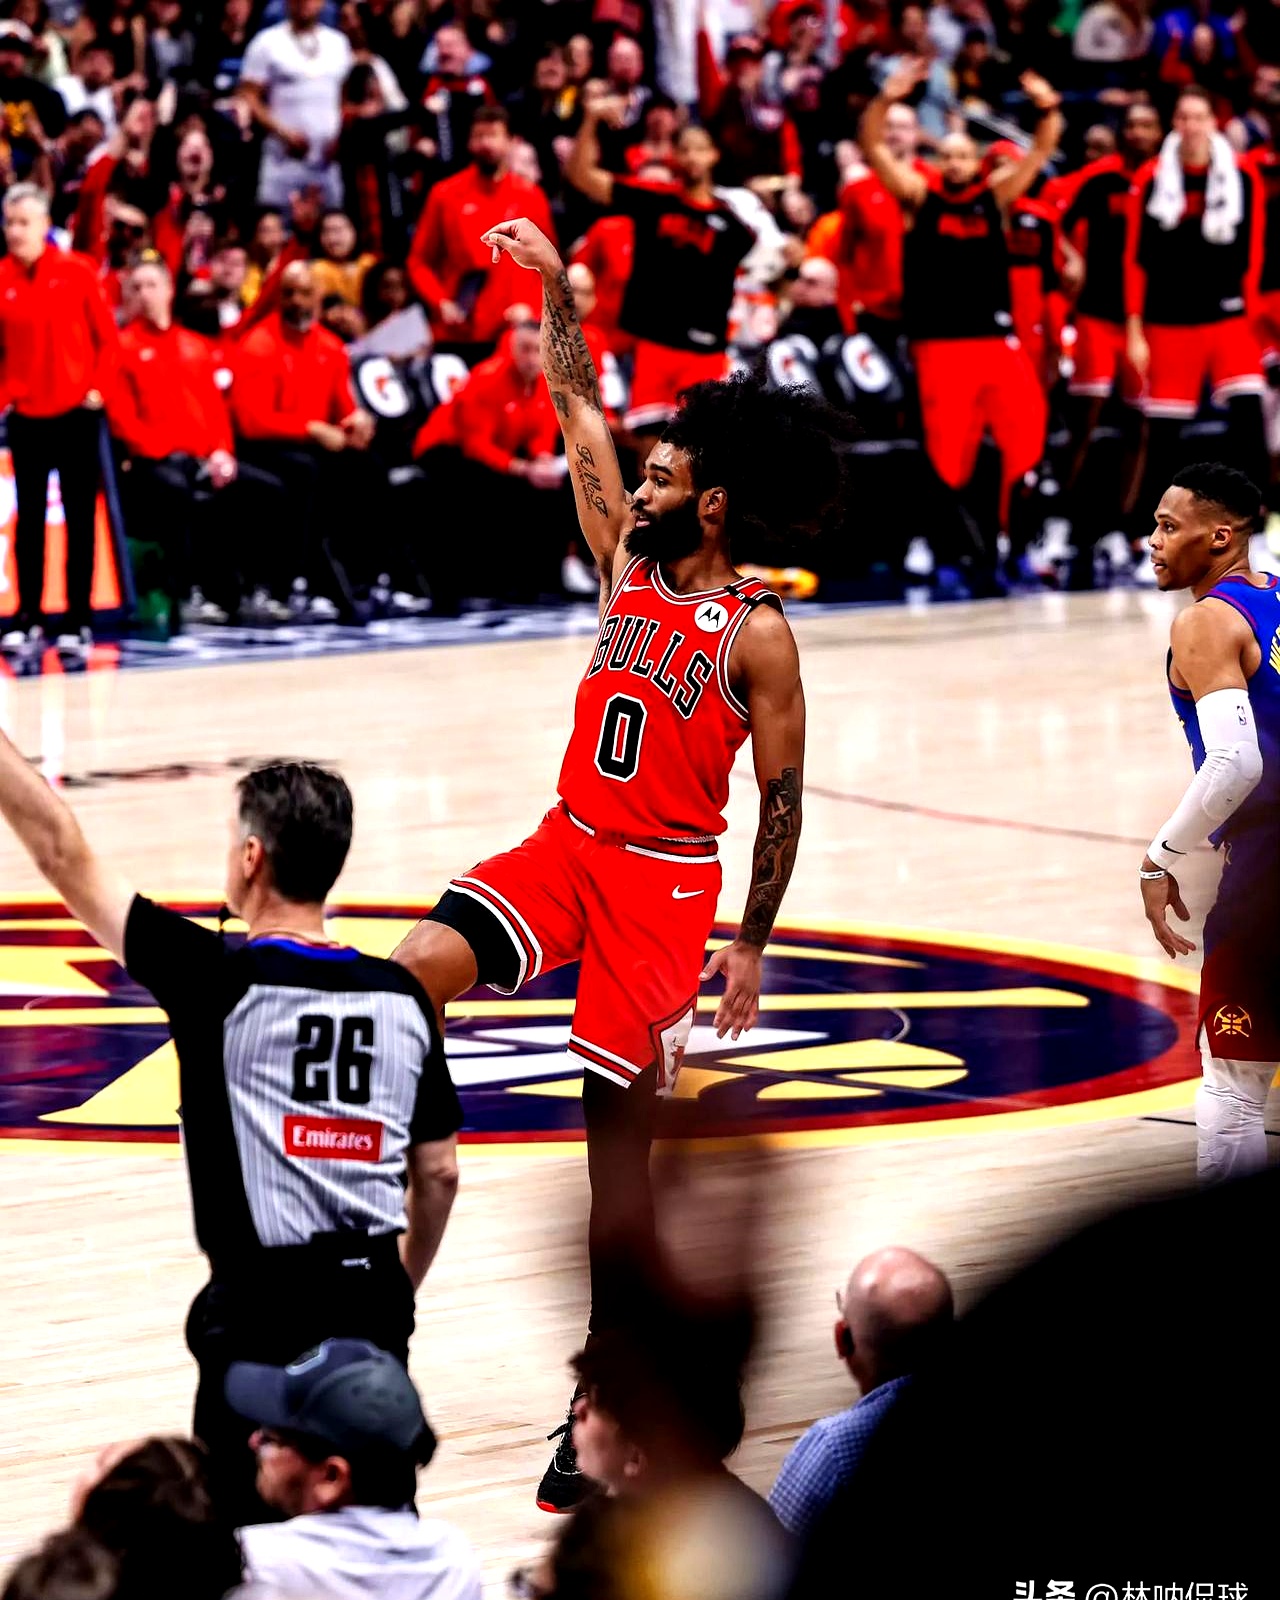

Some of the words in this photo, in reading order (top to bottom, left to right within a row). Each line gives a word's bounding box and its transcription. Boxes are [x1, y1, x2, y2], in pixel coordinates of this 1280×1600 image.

[586, 614, 715, 720] BULLS
[593, 692, 648, 783] 0
[290, 1014, 374, 1105] 26
[292, 1125, 374, 1151] Emirates
